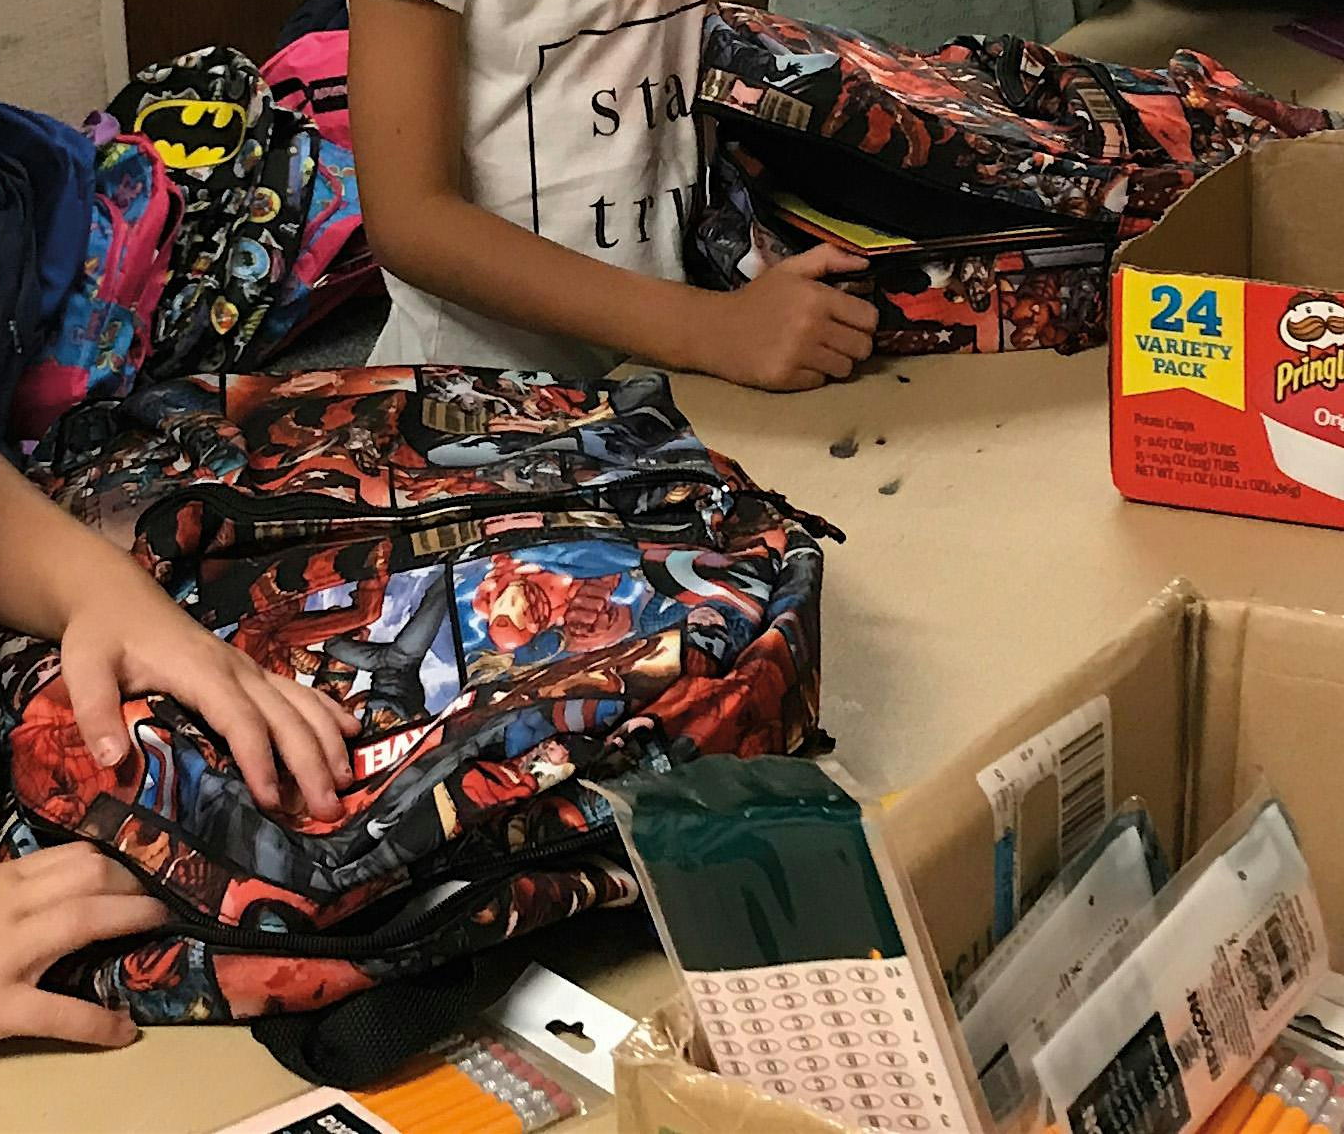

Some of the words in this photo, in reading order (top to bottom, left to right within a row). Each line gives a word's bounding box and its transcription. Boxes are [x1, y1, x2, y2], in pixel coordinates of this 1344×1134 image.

[1150, 285, 1224, 338] 24
[1135, 334, 1233, 362] VARIETY
[1152, 357, 1207, 380] PACK
